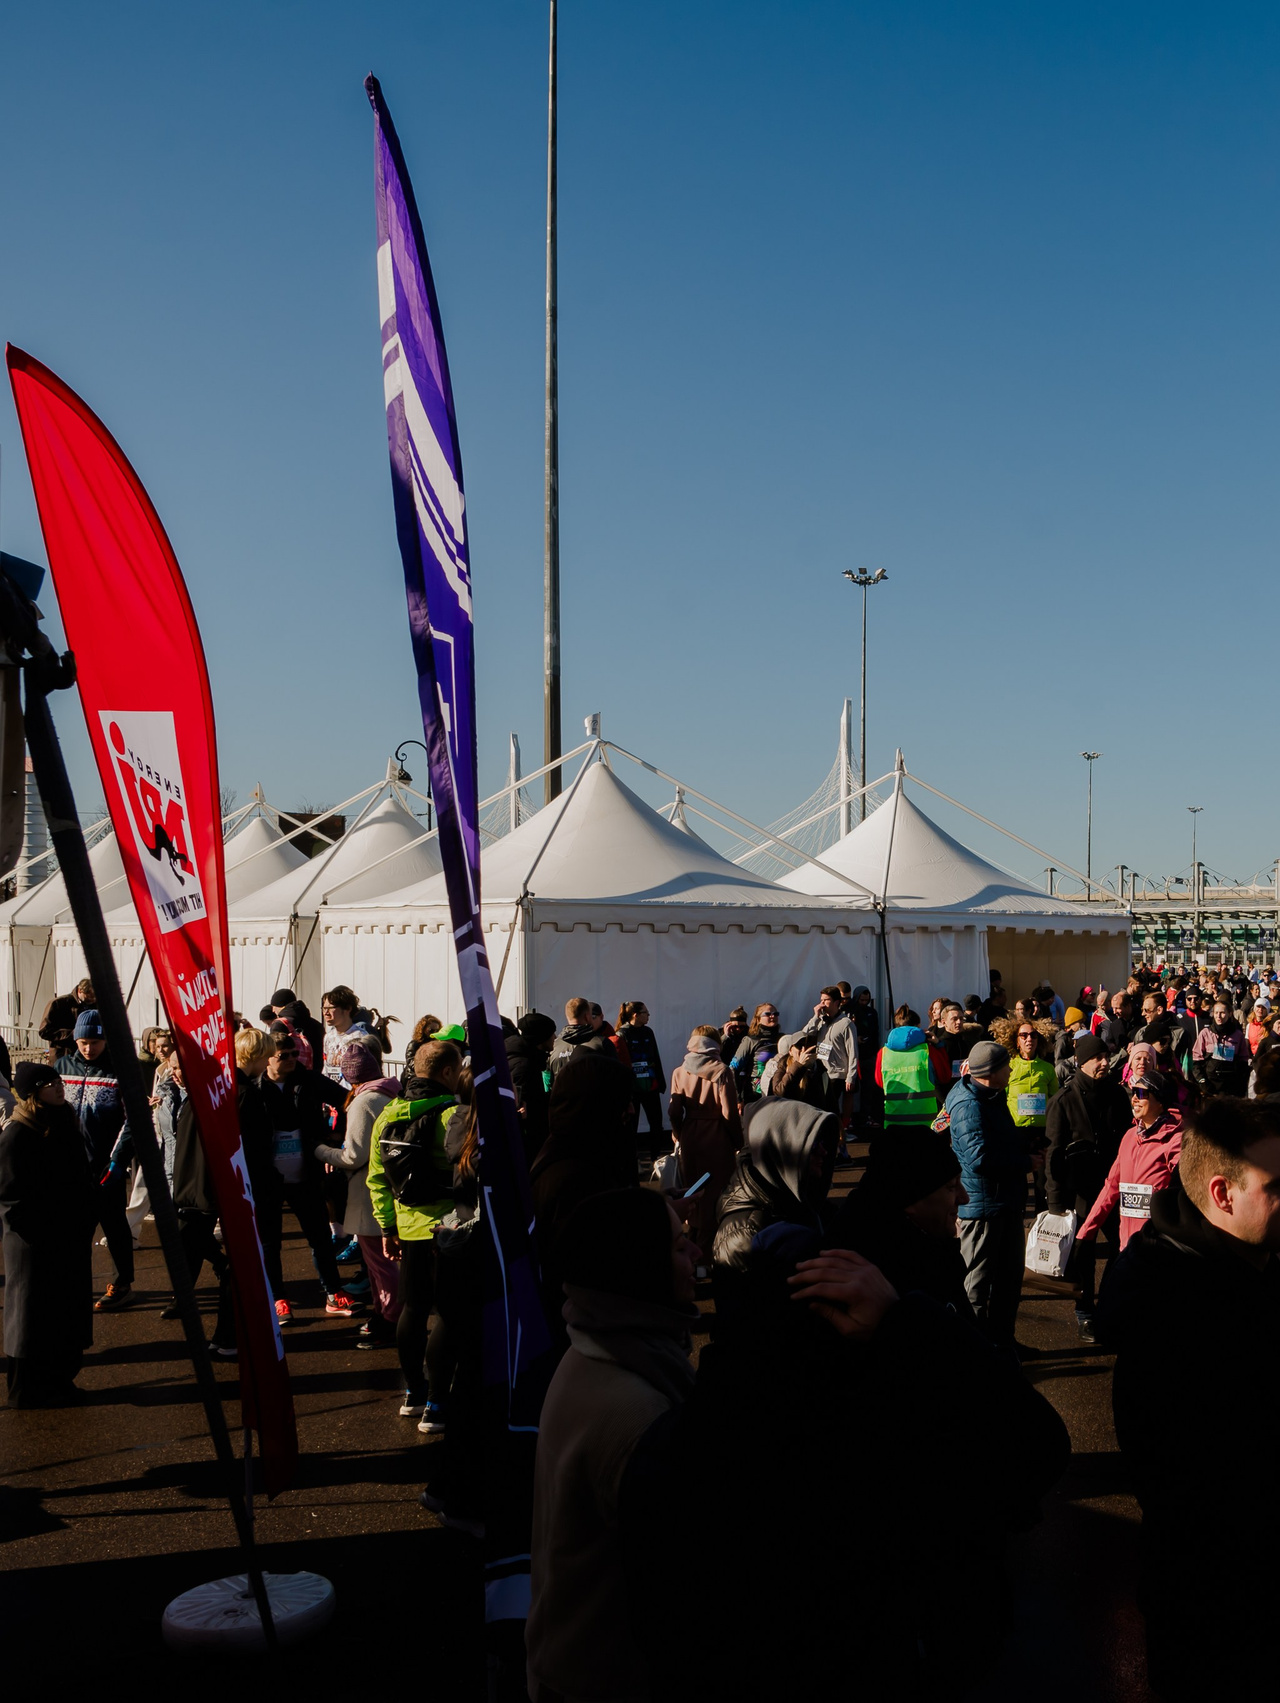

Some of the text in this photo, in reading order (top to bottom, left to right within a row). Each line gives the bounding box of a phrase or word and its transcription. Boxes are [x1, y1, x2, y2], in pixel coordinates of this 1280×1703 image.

[1184, 931, 1191, 940] 4
[1263, 930, 1271, 940] 4
[1123, 1193, 1143, 1204] 3807
